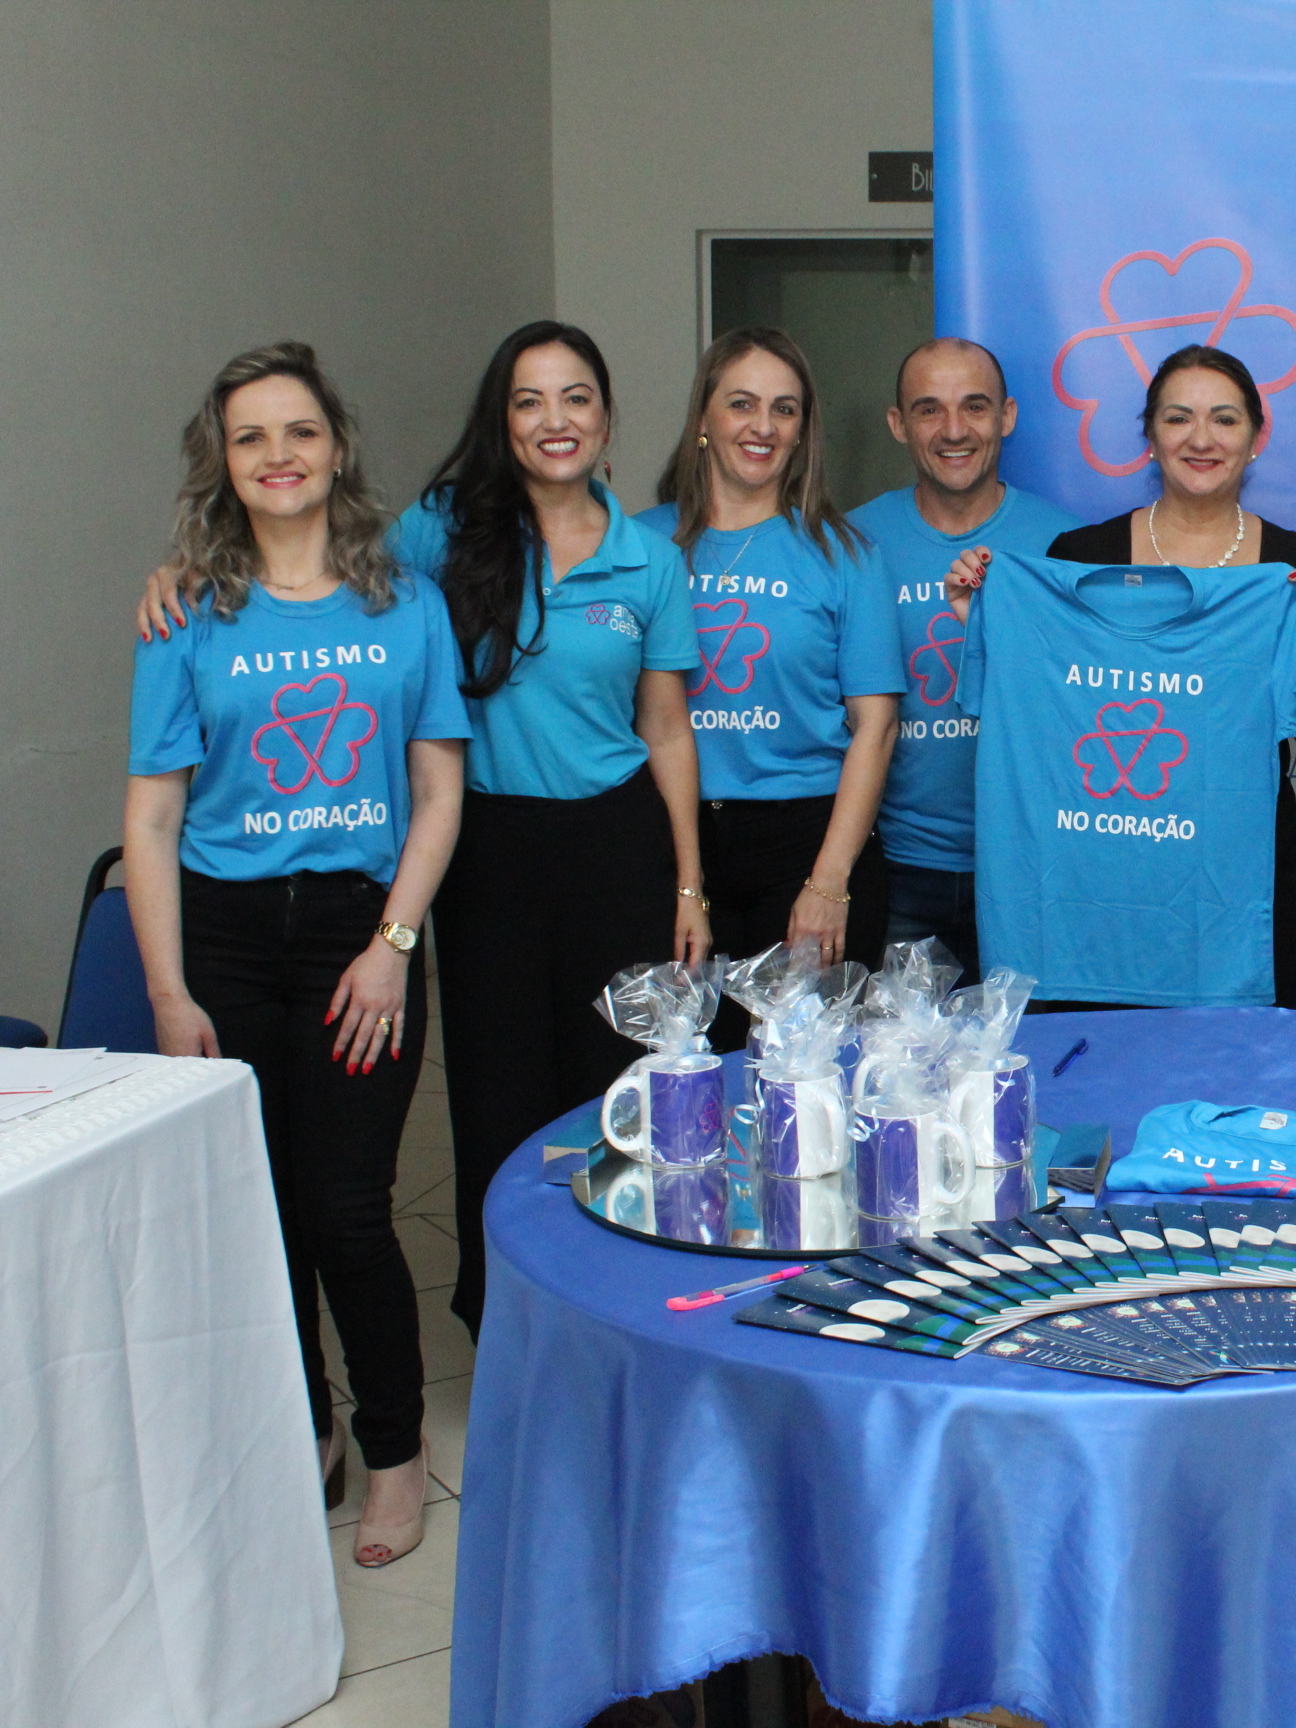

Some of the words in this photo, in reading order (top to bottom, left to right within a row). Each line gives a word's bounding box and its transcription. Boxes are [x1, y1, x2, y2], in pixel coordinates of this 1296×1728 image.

[688, 573, 789, 599] TISMO
[229, 643, 388, 677] AUTISMO
[1065, 663, 1204, 696] AUTISMO
[689, 705, 781, 735] CORAÇÃO
[900, 720, 927, 740] NO
[243, 810, 282, 835] NO
[287, 798, 388, 832] CORAÇÃO
[1056, 808, 1090, 832] NO
[1094, 812, 1196, 843] CORAÇÃO
